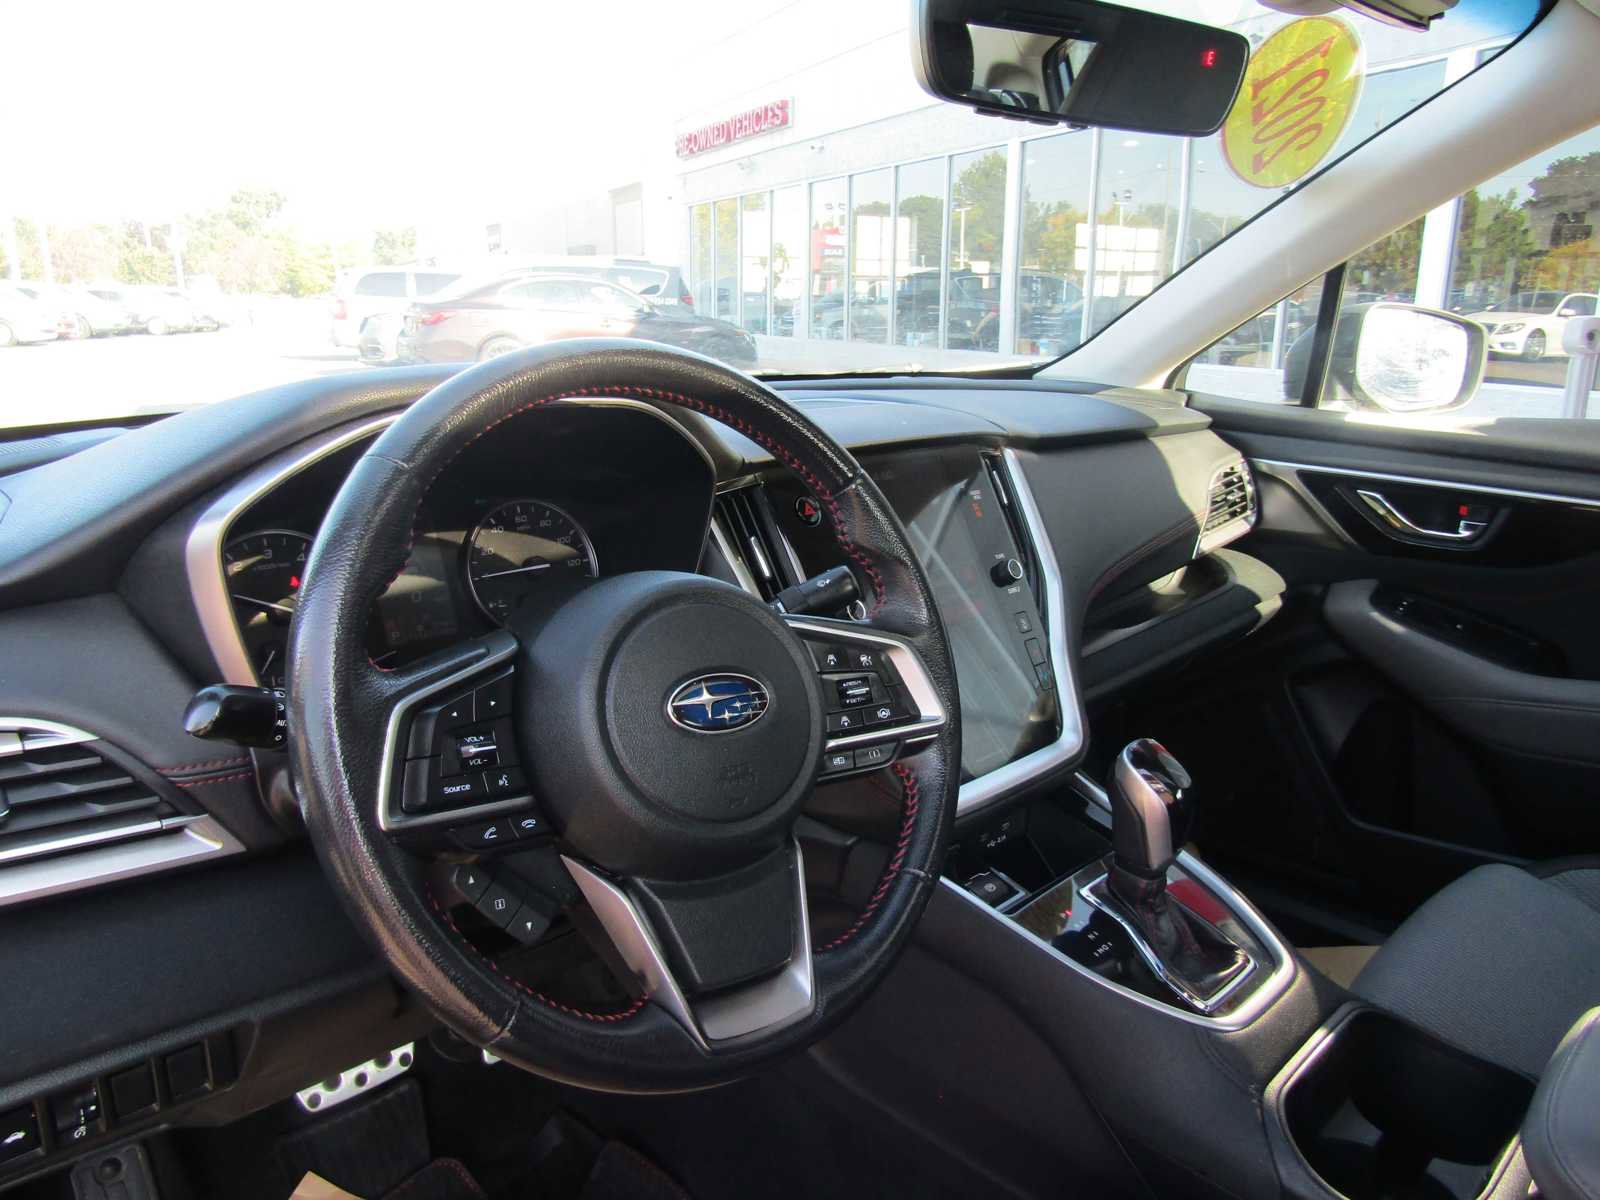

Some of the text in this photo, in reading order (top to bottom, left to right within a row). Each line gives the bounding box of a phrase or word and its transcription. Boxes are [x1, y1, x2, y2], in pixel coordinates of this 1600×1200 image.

[728, 102, 785, 141] VEHICLES
[490, 525, 504, 534] 40
[263, 549, 272, 559] 3
[296, 553, 306, 561] 4
[463, 735, 484, 743] VOL+
